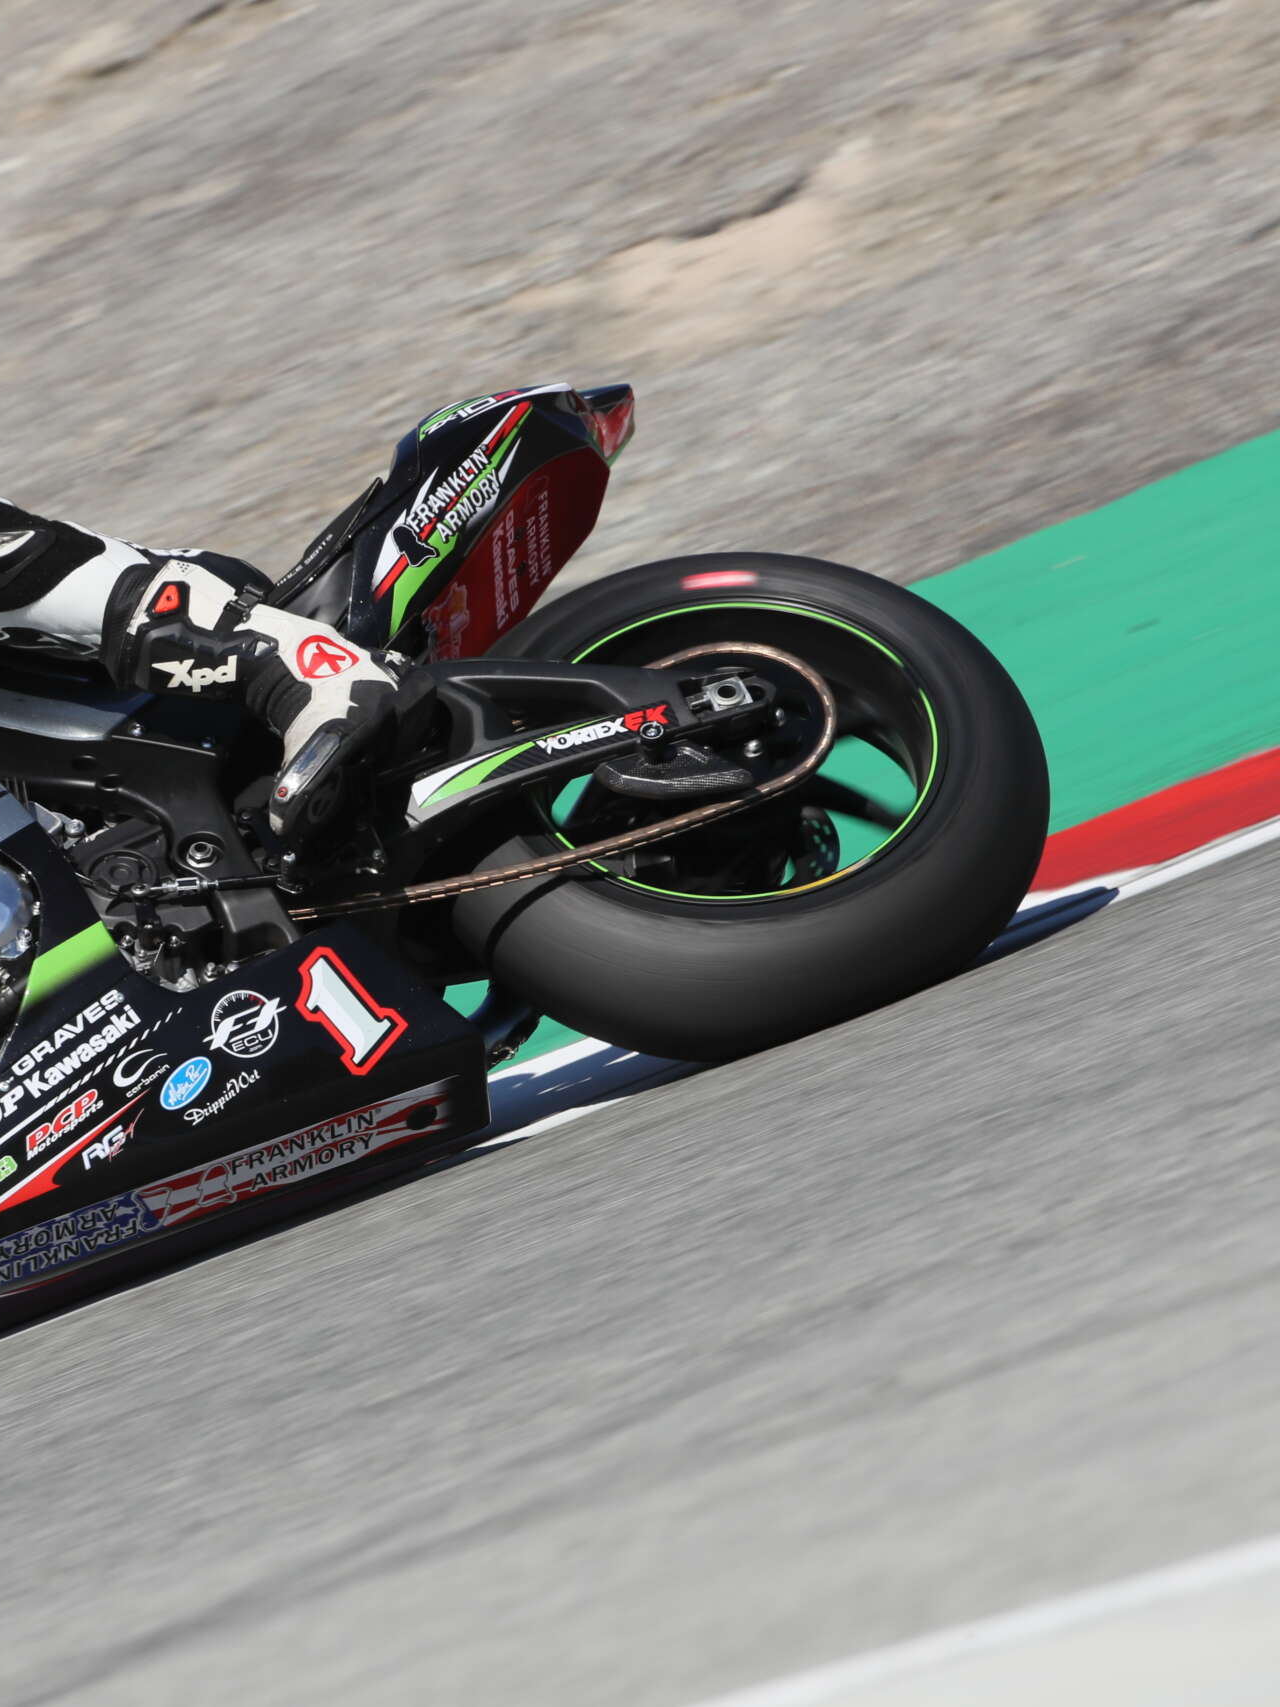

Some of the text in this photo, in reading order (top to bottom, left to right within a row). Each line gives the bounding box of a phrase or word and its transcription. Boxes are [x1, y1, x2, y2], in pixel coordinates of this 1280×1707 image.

[406, 447, 488, 533] FRANKLIN
[436, 468, 500, 541] ARMORY
[505, 512, 519, 608] GRAVES
[526, 518, 540, 586] ARMORY
[538, 491, 552, 576] FRANKLIN
[492, 523, 507, 630] Kawasaki
[151, 655, 237, 693] Xpd
[536, 717, 624, 754] VORTEX
[12, 988, 125, 1076] GRAVES
[231, 1030, 274, 1052] ECU
[300, 952, 402, 1070] 1
[24, 1005, 141, 1098] Kawasaki
[126, 1063, 170, 1098] carbonin
[26, 1089, 98, 1151] PCP
[27, 1099, 104, 1160] Motorsports
[231, 1110, 374, 1176] FRANKLIN
[250, 1134, 375, 1192] ARMORY
